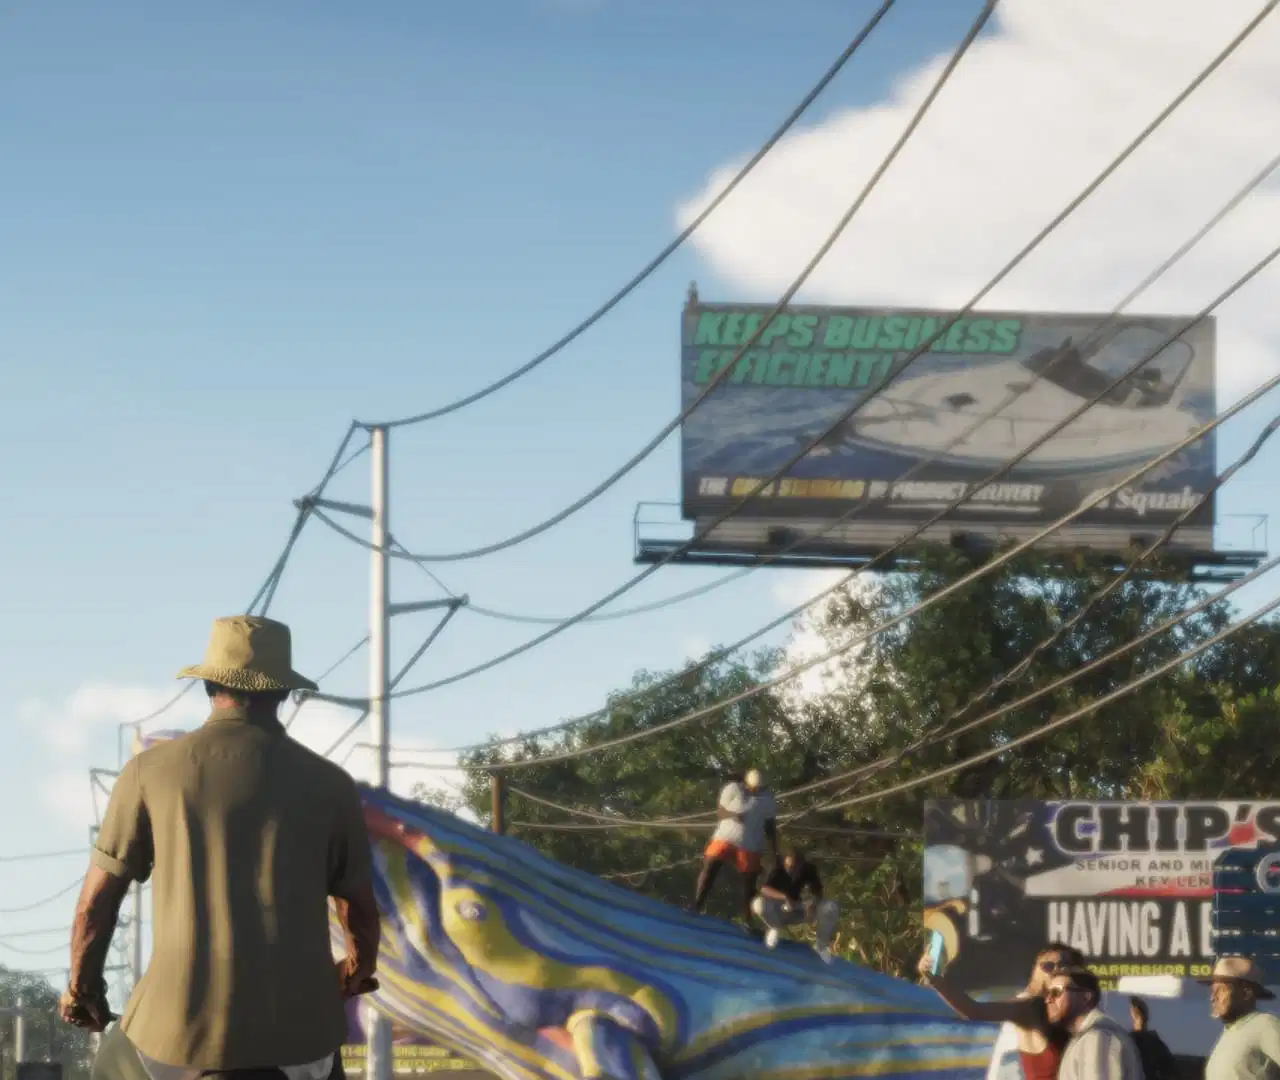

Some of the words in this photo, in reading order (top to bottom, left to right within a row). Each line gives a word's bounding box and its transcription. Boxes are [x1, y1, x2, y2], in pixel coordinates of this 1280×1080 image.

[693, 311, 818, 348] KEEPS
[823, 315, 1022, 352] BUSINESS
[1075, 858, 1142, 873] SENIOR
[1147, 858, 1185, 873] AND
[1047, 900, 1161, 958] HAVING
[1169, 900, 1191, 958] A
